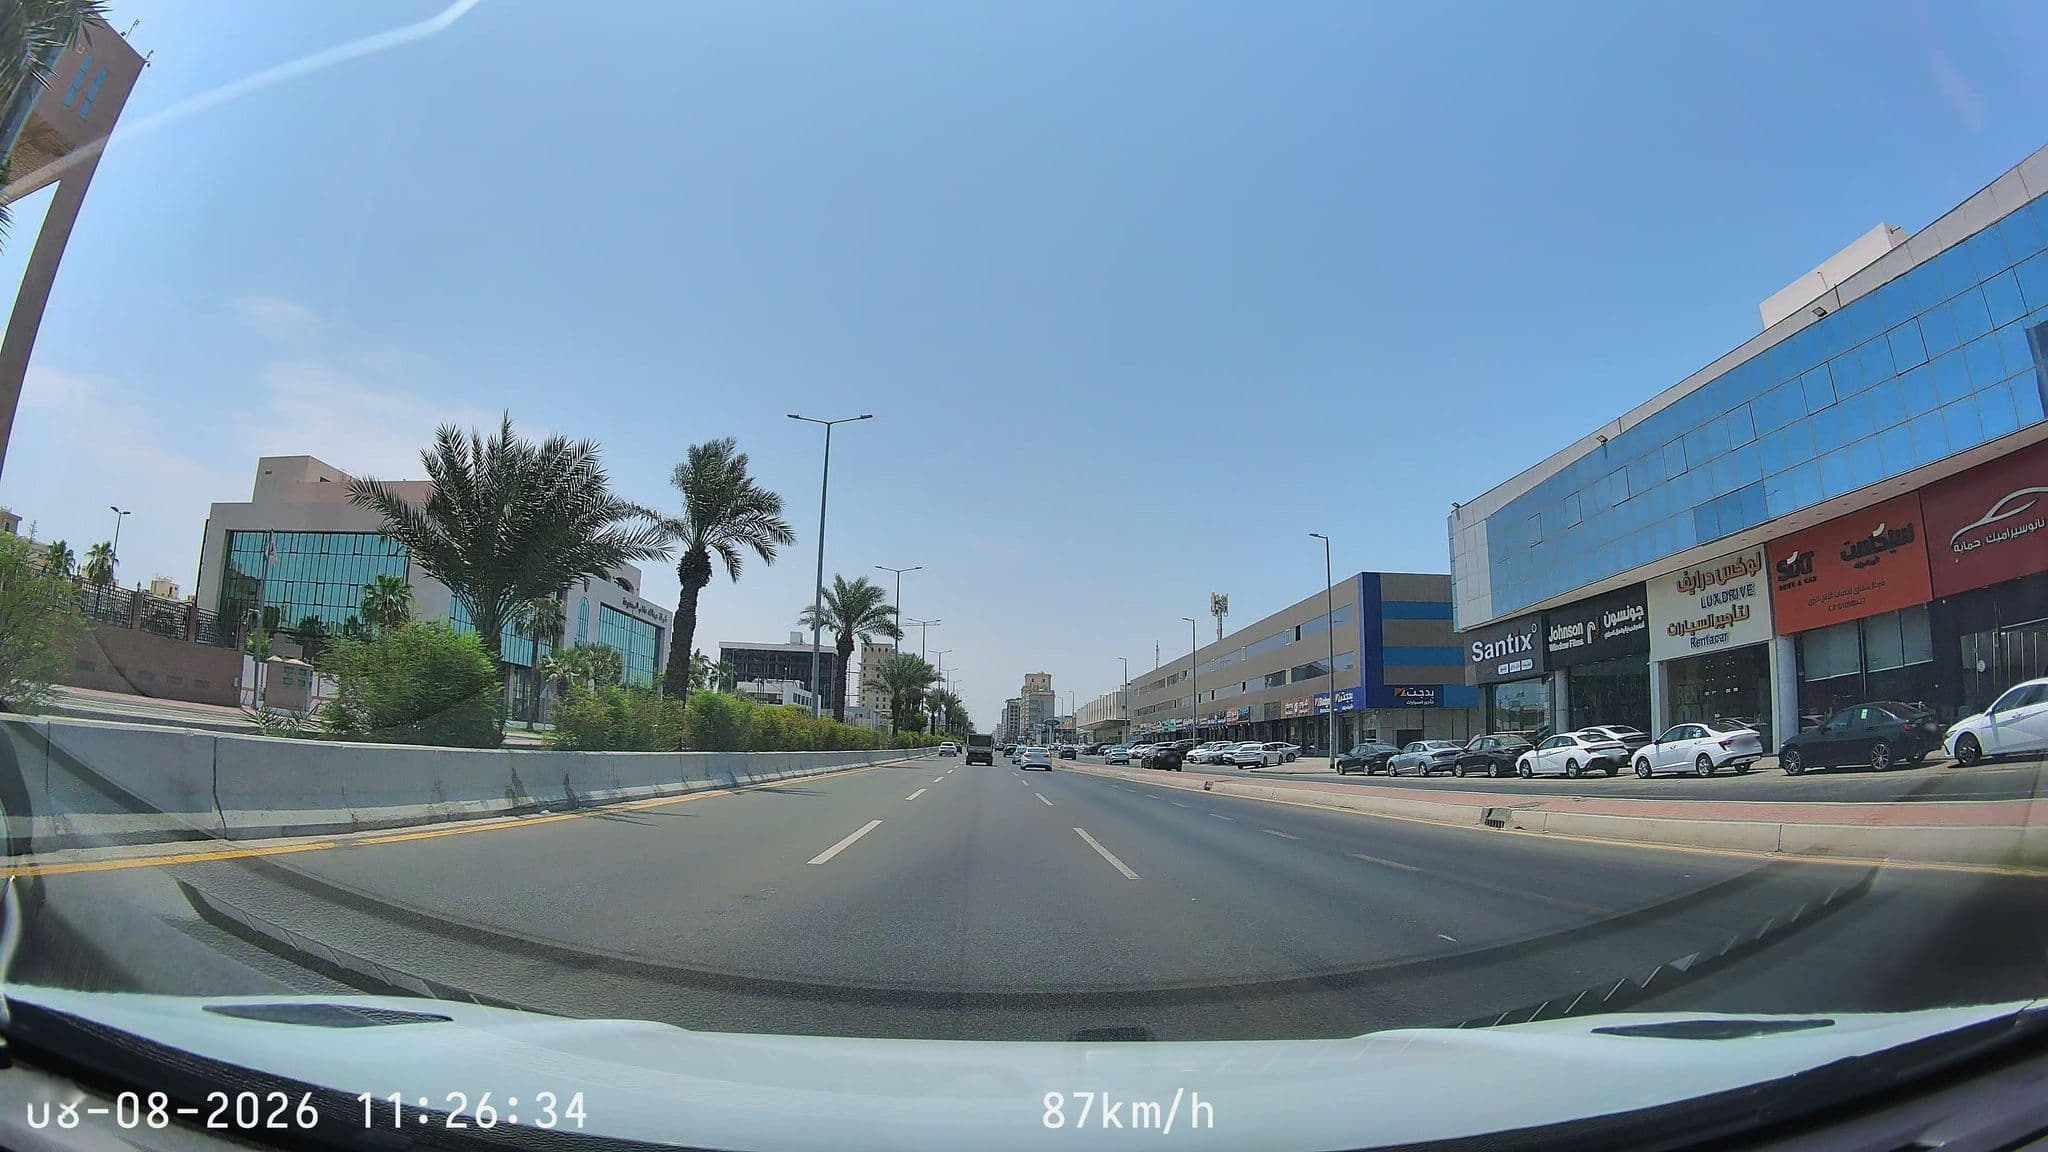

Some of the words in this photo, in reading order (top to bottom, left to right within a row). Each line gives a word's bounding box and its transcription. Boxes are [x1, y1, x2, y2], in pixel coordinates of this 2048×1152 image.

[1953, 539, 1981, 554] حماية
[1676, 570, 1715, 596] درايف
[1603, 605, 1645, 629] جونسون
[1667, 613, 1715, 637] السيارات
[1548, 622, 1584, 642] Johnson
[1472, 633, 1532, 662] Santix
[1406, 687, 1435, 699] بدجت
